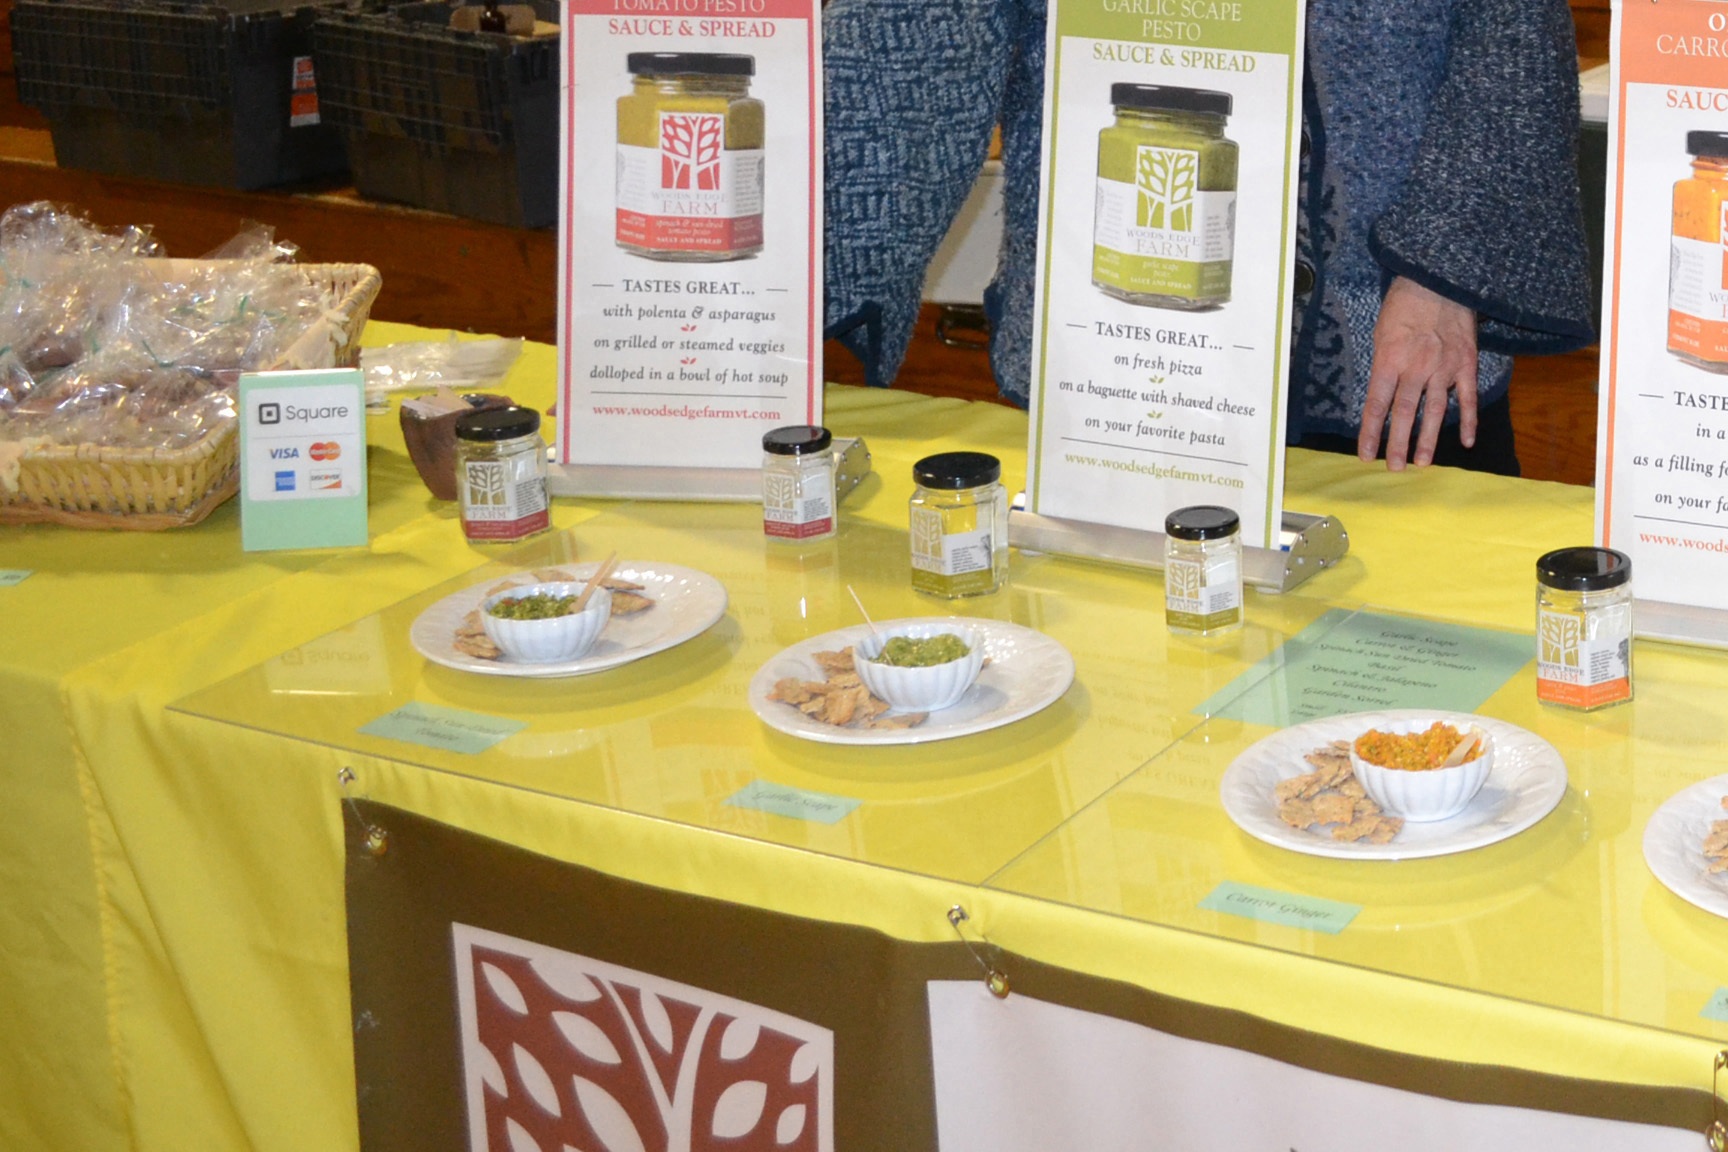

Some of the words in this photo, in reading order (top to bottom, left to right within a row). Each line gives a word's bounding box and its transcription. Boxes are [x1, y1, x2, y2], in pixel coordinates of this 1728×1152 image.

[1181, 0, 1242, 22] SCAPE
[609, 19, 673, 36] SAUCE
[678, 20, 694, 36] &
[699, 20, 775, 37] SPREAD
[1142, 19, 1201, 40] PESTO
[1093, 43, 1155, 64] SAUCE
[1160, 50, 1175, 66] &
[1181, 50, 1255, 72] SPREAD
[663, 201, 718, 215] FARM
[1126, 228, 1164, 240] WOODS
[1136, 239, 1189, 258] FARM
[623, 279, 681, 293] TASTES
[686, 281, 755, 295] GREAT...
[603, 305, 633, 317] with
[638, 306, 686, 320] polenta
[692, 306, 704, 319] &
[709, 310, 775, 323] asparagus
[594, 338, 610, 348] on
[614, 336, 657, 351] grilled
[661, 340, 675, 350] or
[680, 338, 734, 351] steamed
[739, 340, 785, 355] veggies
[1095, 322, 1151, 341] TASTES
[1156, 329, 1222, 350] GREAT...
[1114, 355, 1129, 366] on
[1132, 356, 1164, 370] fresh
[1169, 359, 1202, 375] pizza
[590, 365, 644, 382] dolloped
[649, 367, 662, 380] in
[667, 371, 675, 380] a
[680, 368, 710, 382] bowl
[715, 369, 728, 384] of
[732, 369, 753, 383] hot
[758, 373, 788, 386] soup
[1059, 381, 1073, 392] on
[1077, 384, 1084, 393] a
[1087, 380, 1137, 400] baguette
[1141, 390, 1168, 404] with
[1171, 393, 1213, 411] shaved
[1216, 400, 1255, 416] cheese
[285, 402, 349, 423] Square
[592, 404, 781, 420] www.woodsedgefarmvt.com
[1085, 418, 1100, 428] on
[1104, 421, 1132, 433] your
[1136, 421, 1185, 440] favorite
[1190, 430, 1225, 445] pasta
[1696, 423, 1710, 438] in
[1717, 429, 1725, 439] a
[269, 448, 299, 459] VISA
[1065, 451, 1245, 489] www.woodsedgefarmvt.com
[1633, 455, 1648, 466] as
[1655, 458, 1663, 468] a
[1668, 455, 1713, 477] filling
[1655, 492, 1672, 504] on
[1678, 497, 1711, 509] your
[1544, 669, 1578, 683] FARM
[1226, 892, 1276, 908] Carrot
[1279, 904, 1334, 919] Ginger
